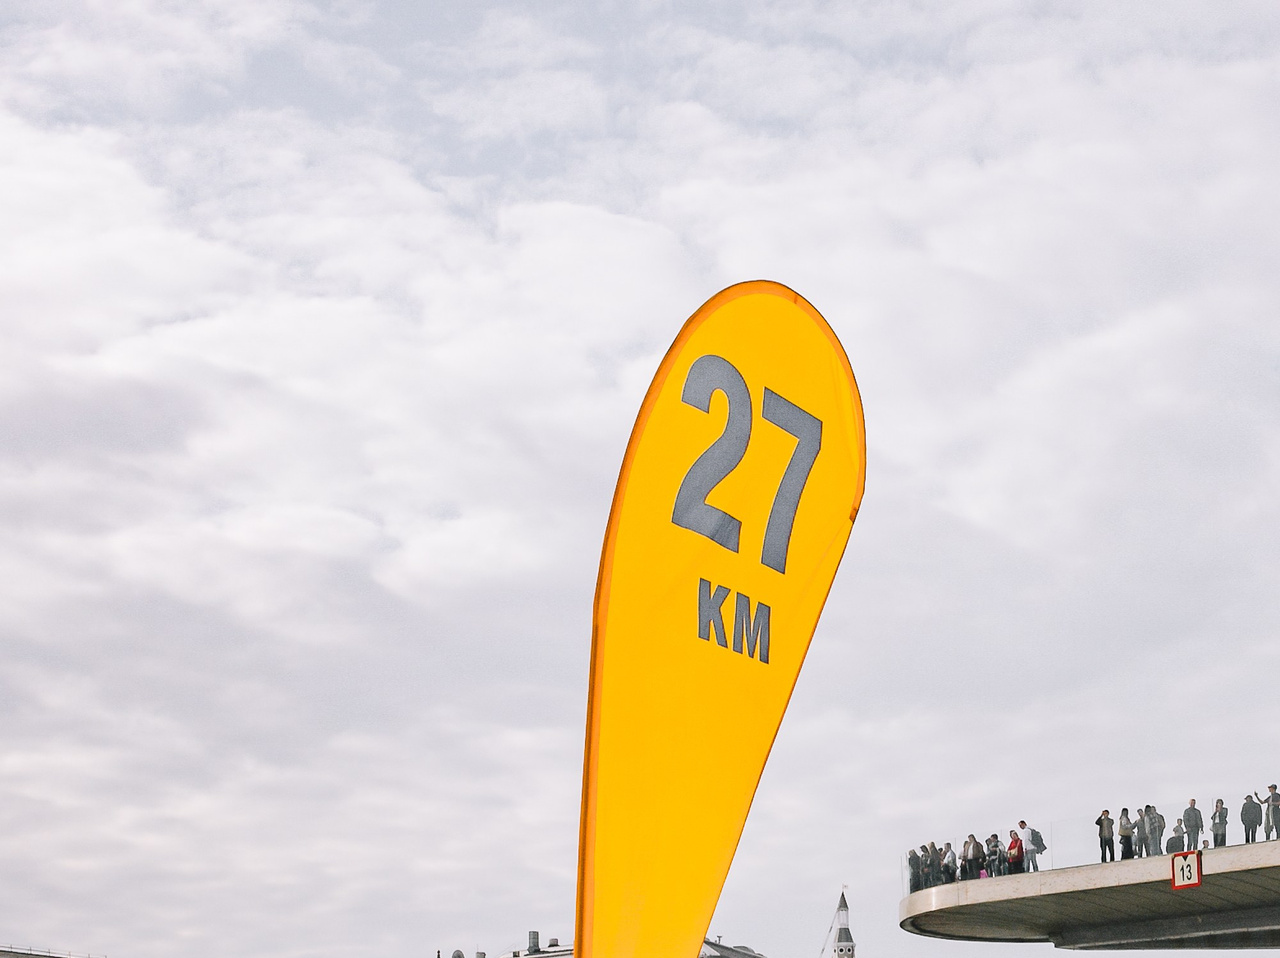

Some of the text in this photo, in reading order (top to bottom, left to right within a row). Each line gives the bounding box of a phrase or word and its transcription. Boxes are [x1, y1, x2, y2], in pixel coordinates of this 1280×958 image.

[672, 354, 823, 575] 27
[698, 577, 771, 665] KM
[1180, 864, 1192, 881] 13
